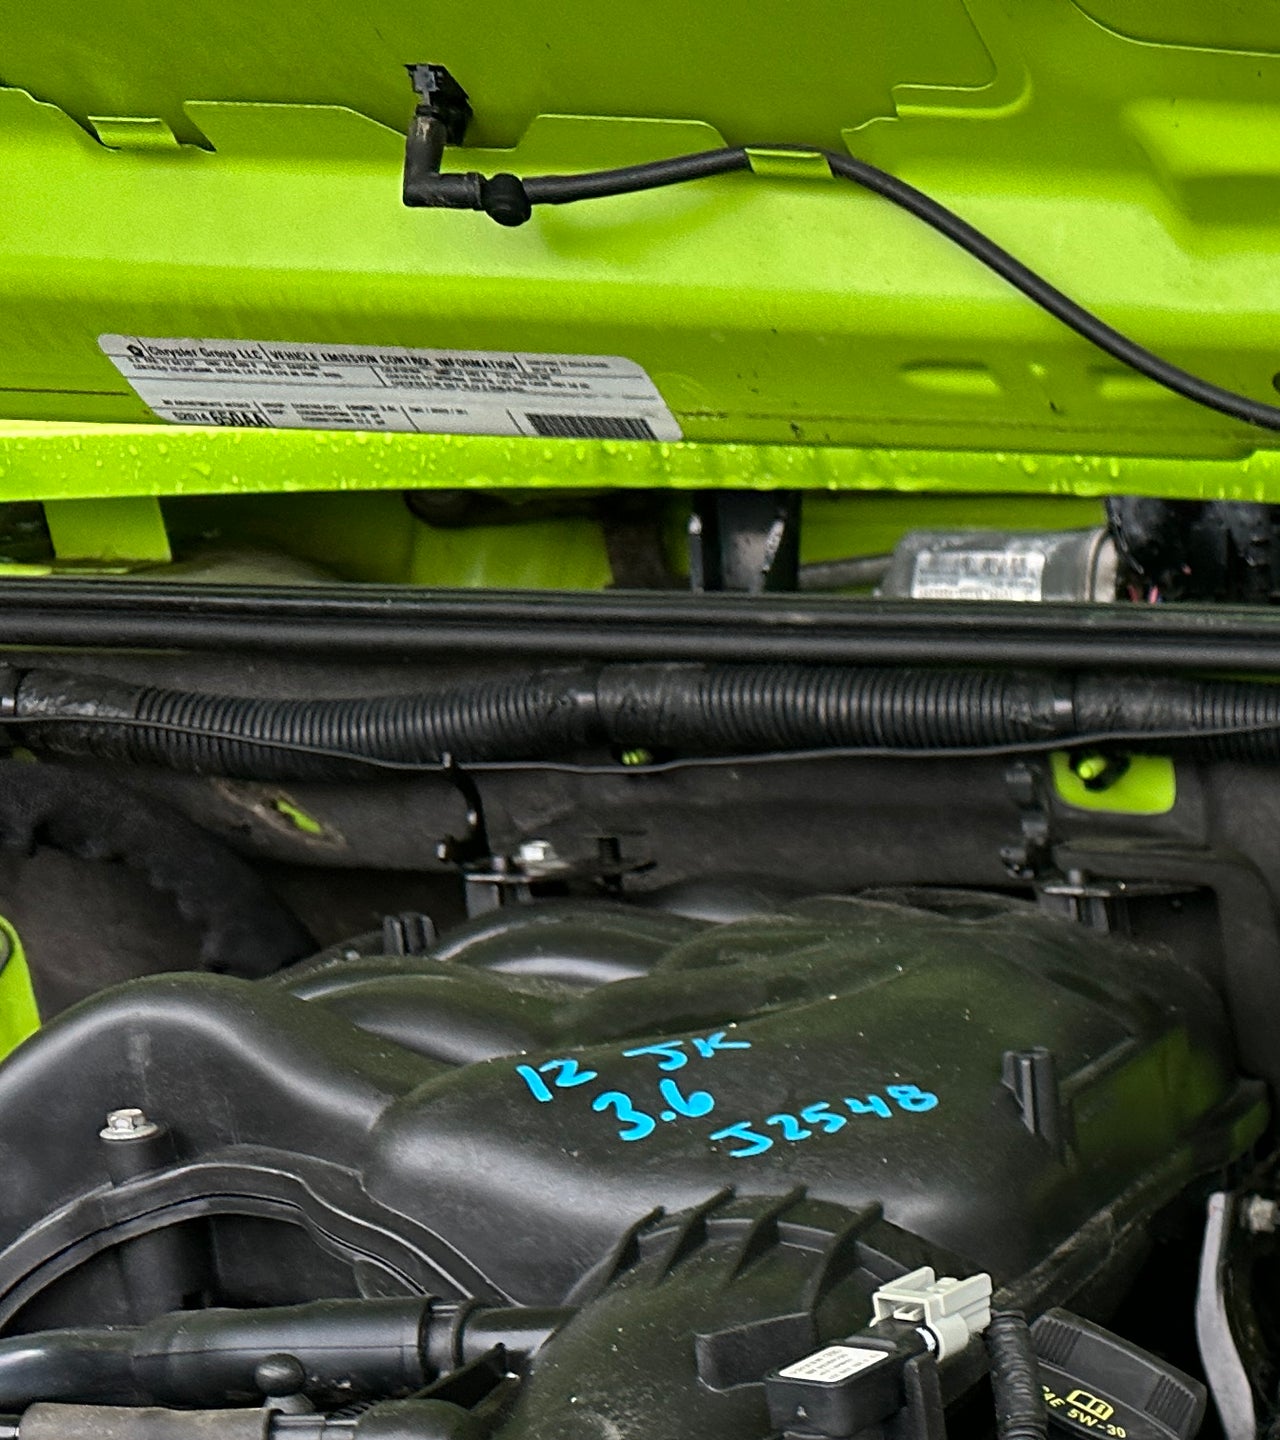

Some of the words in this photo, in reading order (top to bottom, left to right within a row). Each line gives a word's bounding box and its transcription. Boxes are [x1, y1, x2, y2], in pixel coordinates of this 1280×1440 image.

[148, 346, 198, 360] Chrysler
[199, 347, 237, 360] Group
[237, 349, 263, 360] LLC
[320, 352, 380, 364] EMISSION
[434, 357, 519, 370] INFORMATION
[516, 1058, 597, 1102] 12
[623, 1031, 752, 1072] JK
[593, 1078, 716, 1141] 3.6
[710, 1084, 939, 1159] J2548
[1066, 1408, 1127, 1439] 5W-30
